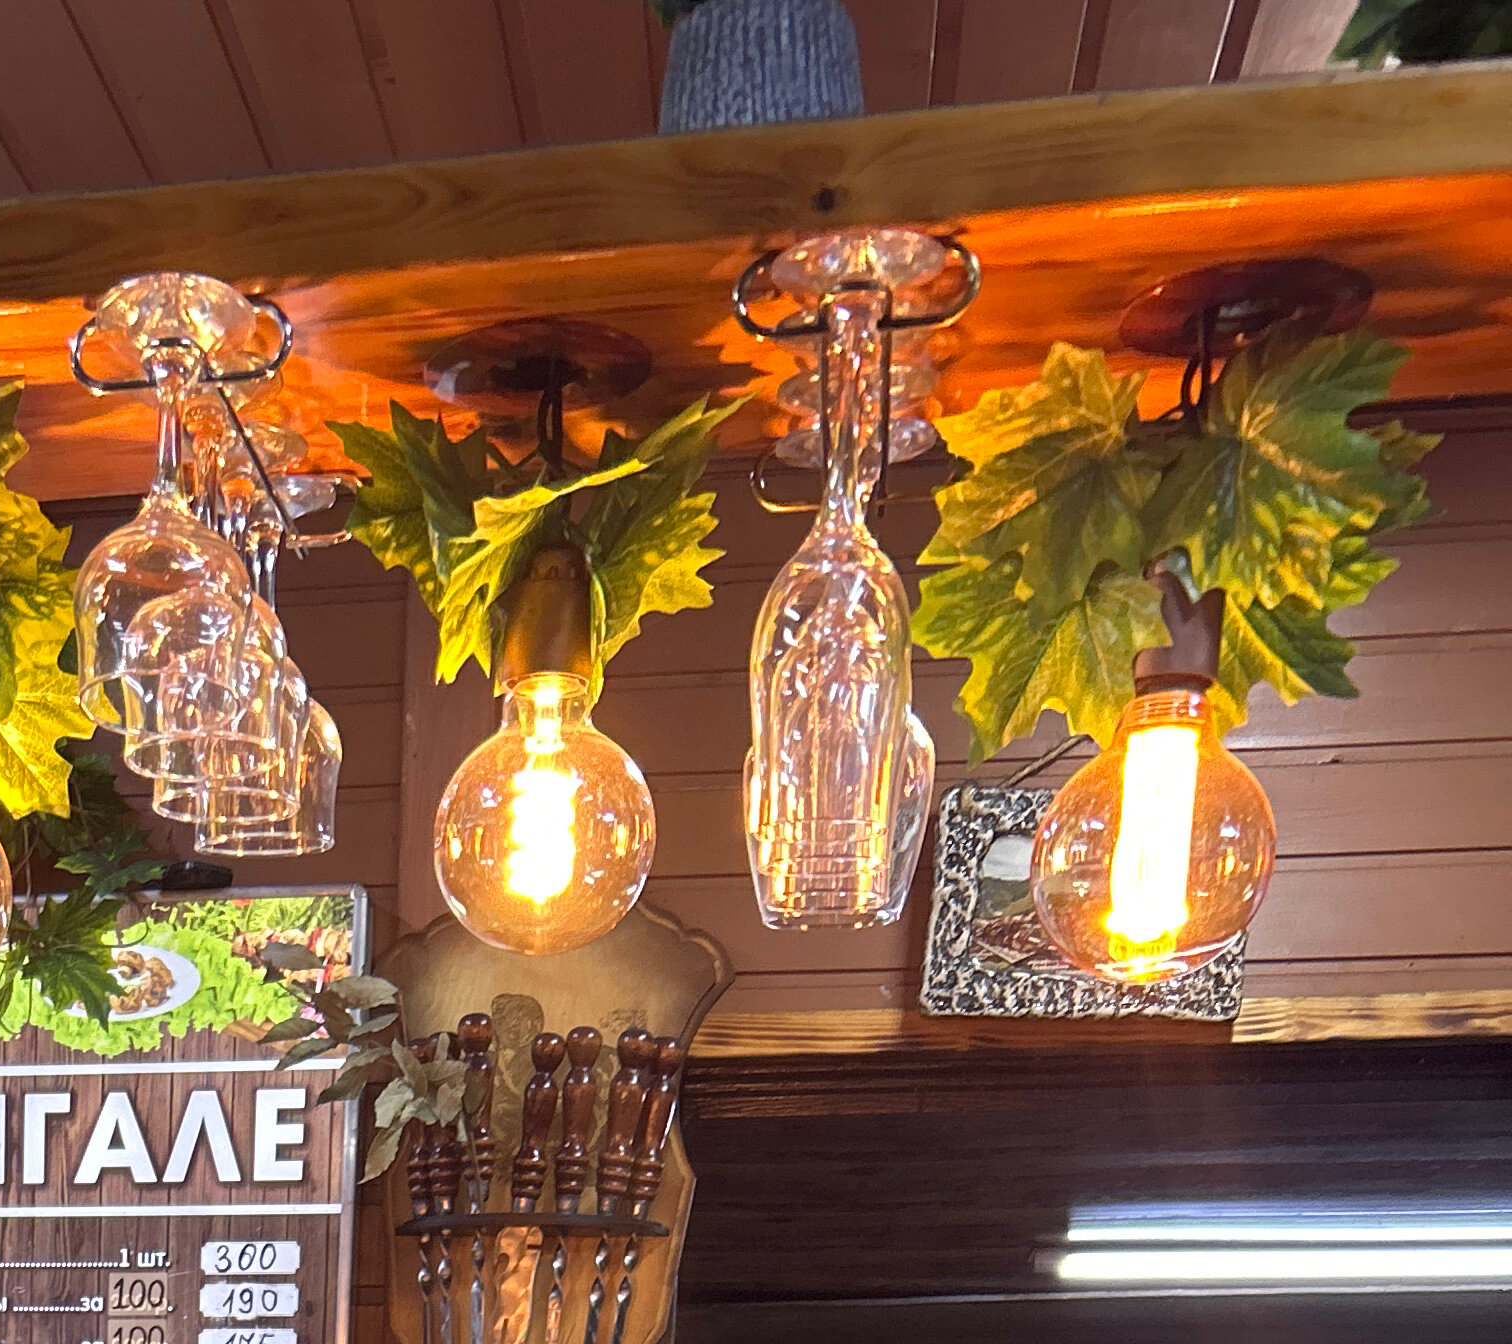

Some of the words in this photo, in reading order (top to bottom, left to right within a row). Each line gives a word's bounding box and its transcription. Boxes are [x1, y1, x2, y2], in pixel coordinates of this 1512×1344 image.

[119, 1248, 129, 1267] 1
[138, 1252, 170, 1267] шт.
[222, 1288, 278, 1314] 190
